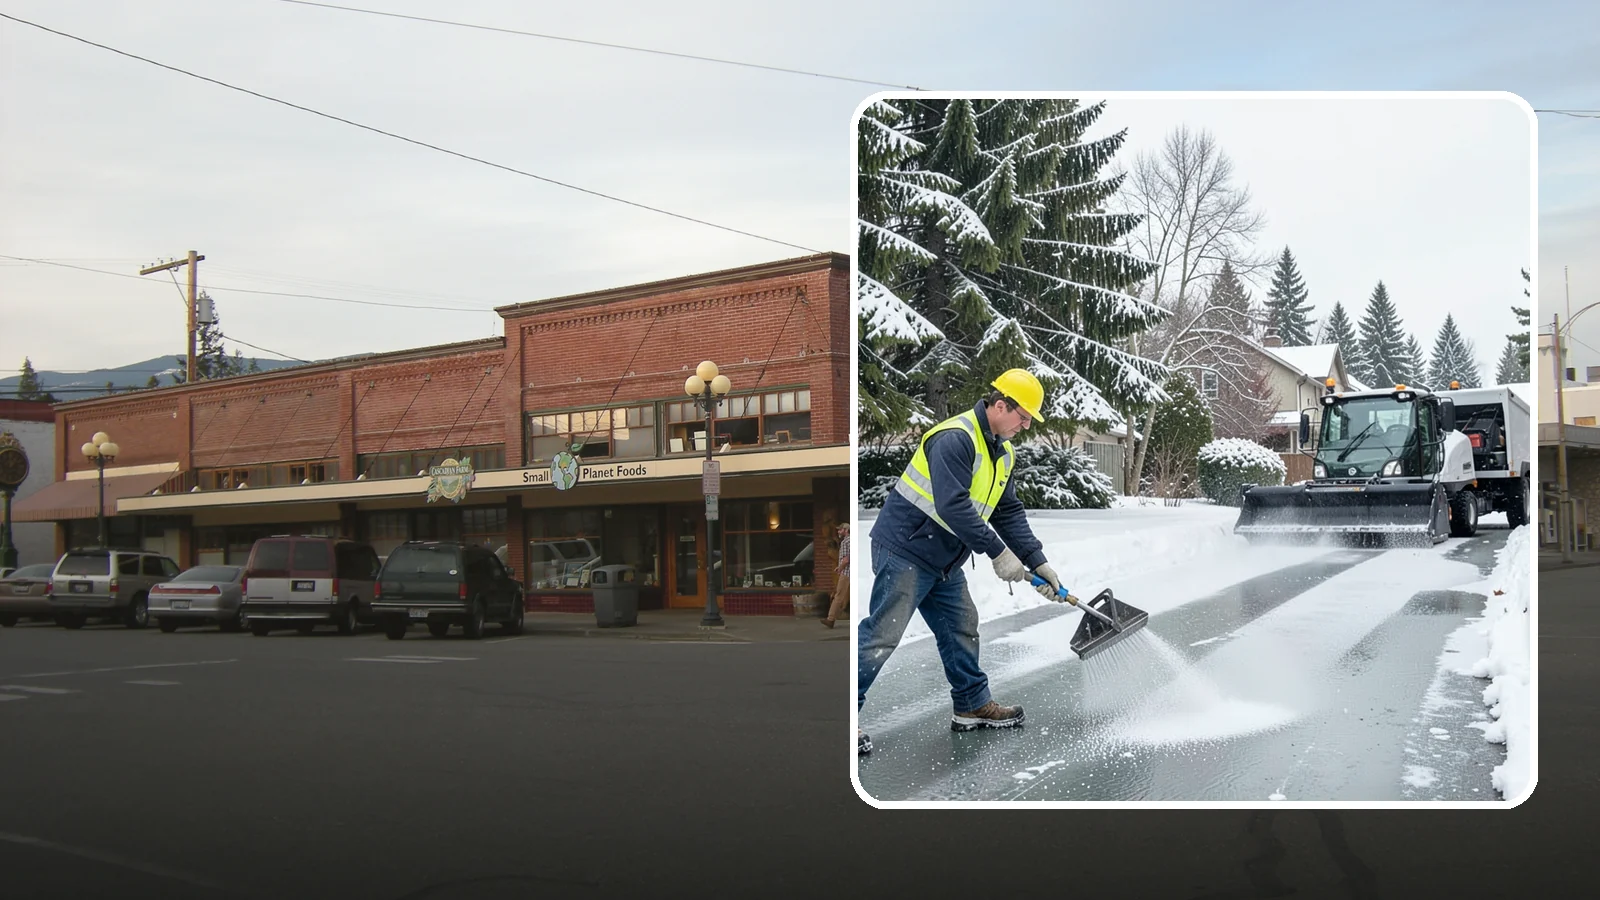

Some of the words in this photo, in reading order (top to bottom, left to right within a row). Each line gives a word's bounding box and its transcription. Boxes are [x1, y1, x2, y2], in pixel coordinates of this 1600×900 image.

[523, 471, 549, 483] Small
[583, 467, 614, 479] Planet
[616, 464, 647, 477] Foods
